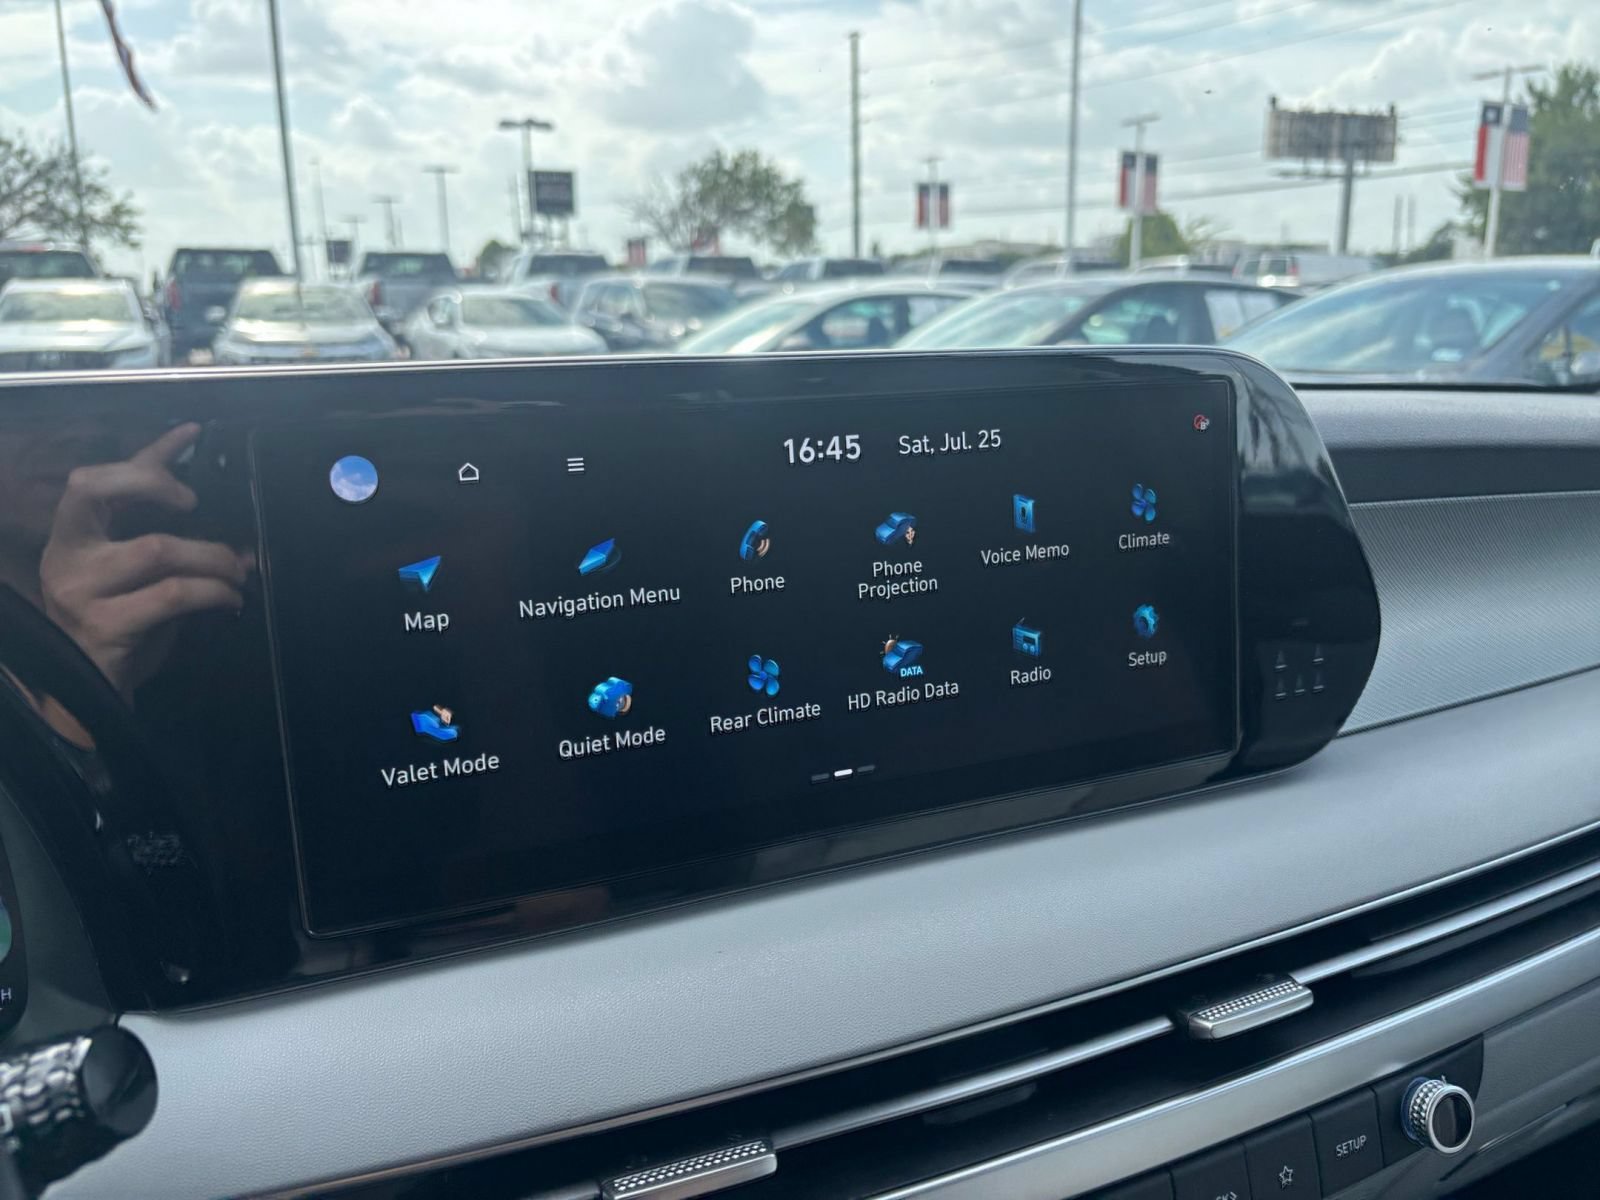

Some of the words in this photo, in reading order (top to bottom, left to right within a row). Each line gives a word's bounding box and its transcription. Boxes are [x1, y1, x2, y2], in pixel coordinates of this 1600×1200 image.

[783, 434, 861, 464] 16:45
[898, 435, 935, 455] Sat,
[939, 431, 972, 452] Jul.
[977, 428, 1001, 449] 25
[1118, 531, 1170, 550] Climate
[980, 547, 1021, 565] Voice
[1025, 544, 1070, 560] Memo
[872, 560, 923, 577] Phone
[730, 575, 785, 594] Phone
[858, 577, 938, 600] Projection
[519, 591, 624, 618] Navigation
[629, 587, 680, 606] Menu
[404, 611, 450, 632] Map
[1128, 650, 1167, 667] Setup
[900, 665, 924, 678] DATA
[1010, 667, 1052, 685] Radio
[848, 692, 871, 711] HD
[875, 688, 921, 706] Radio
[924, 681, 959, 699] Data
[710, 714, 753, 733] Rear
[756, 702, 821, 725] Climate
[559, 736, 611, 759] Quiet
[615, 725, 666, 749] Mode
[380, 762, 439, 786] Valet
[443, 752, 500, 777] Mode
[1335, 1134, 1367, 1157] SETUP
